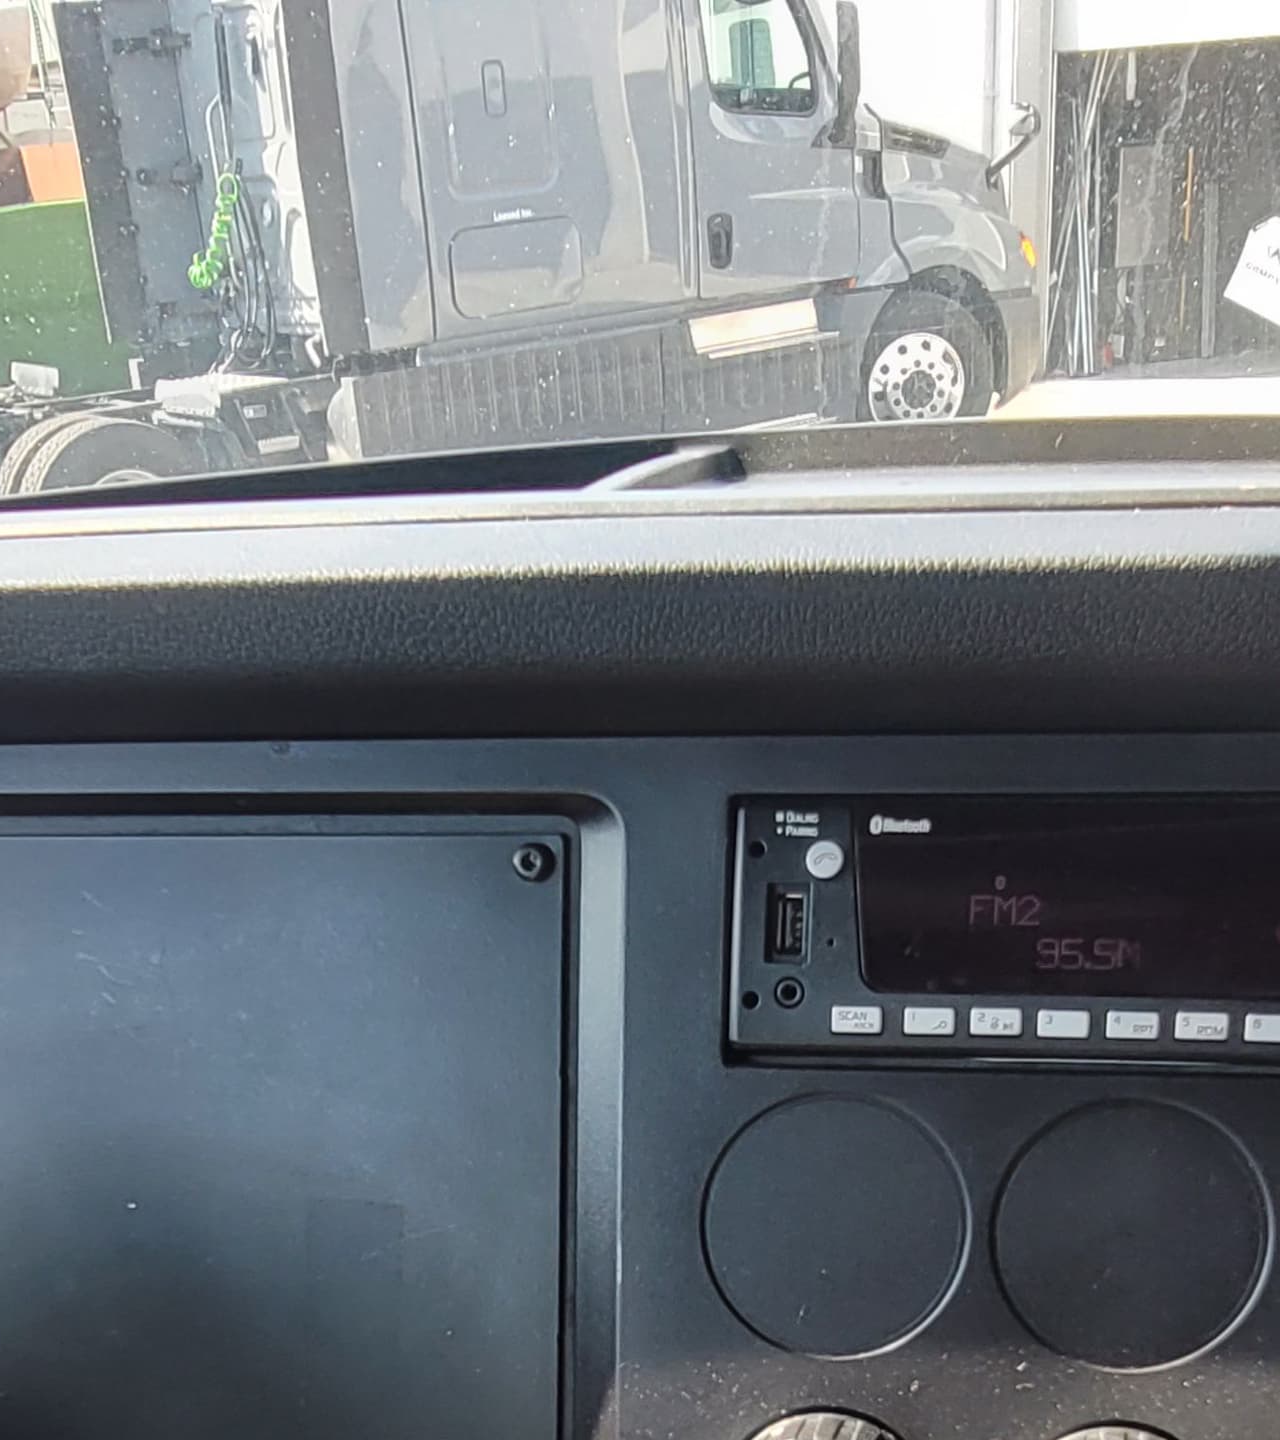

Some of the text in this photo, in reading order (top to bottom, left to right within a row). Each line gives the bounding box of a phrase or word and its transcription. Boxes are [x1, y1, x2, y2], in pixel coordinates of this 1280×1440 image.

[882, 817, 932, 833] Bluetooth
[969, 894, 1041, 926] FM2
[838, 1010, 869, 1022] SCAN
[977, 1012, 986, 1023] 2
[1044, 1014, 1053, 1025] 3
[1182, 1016, 1191, 1027] 5
